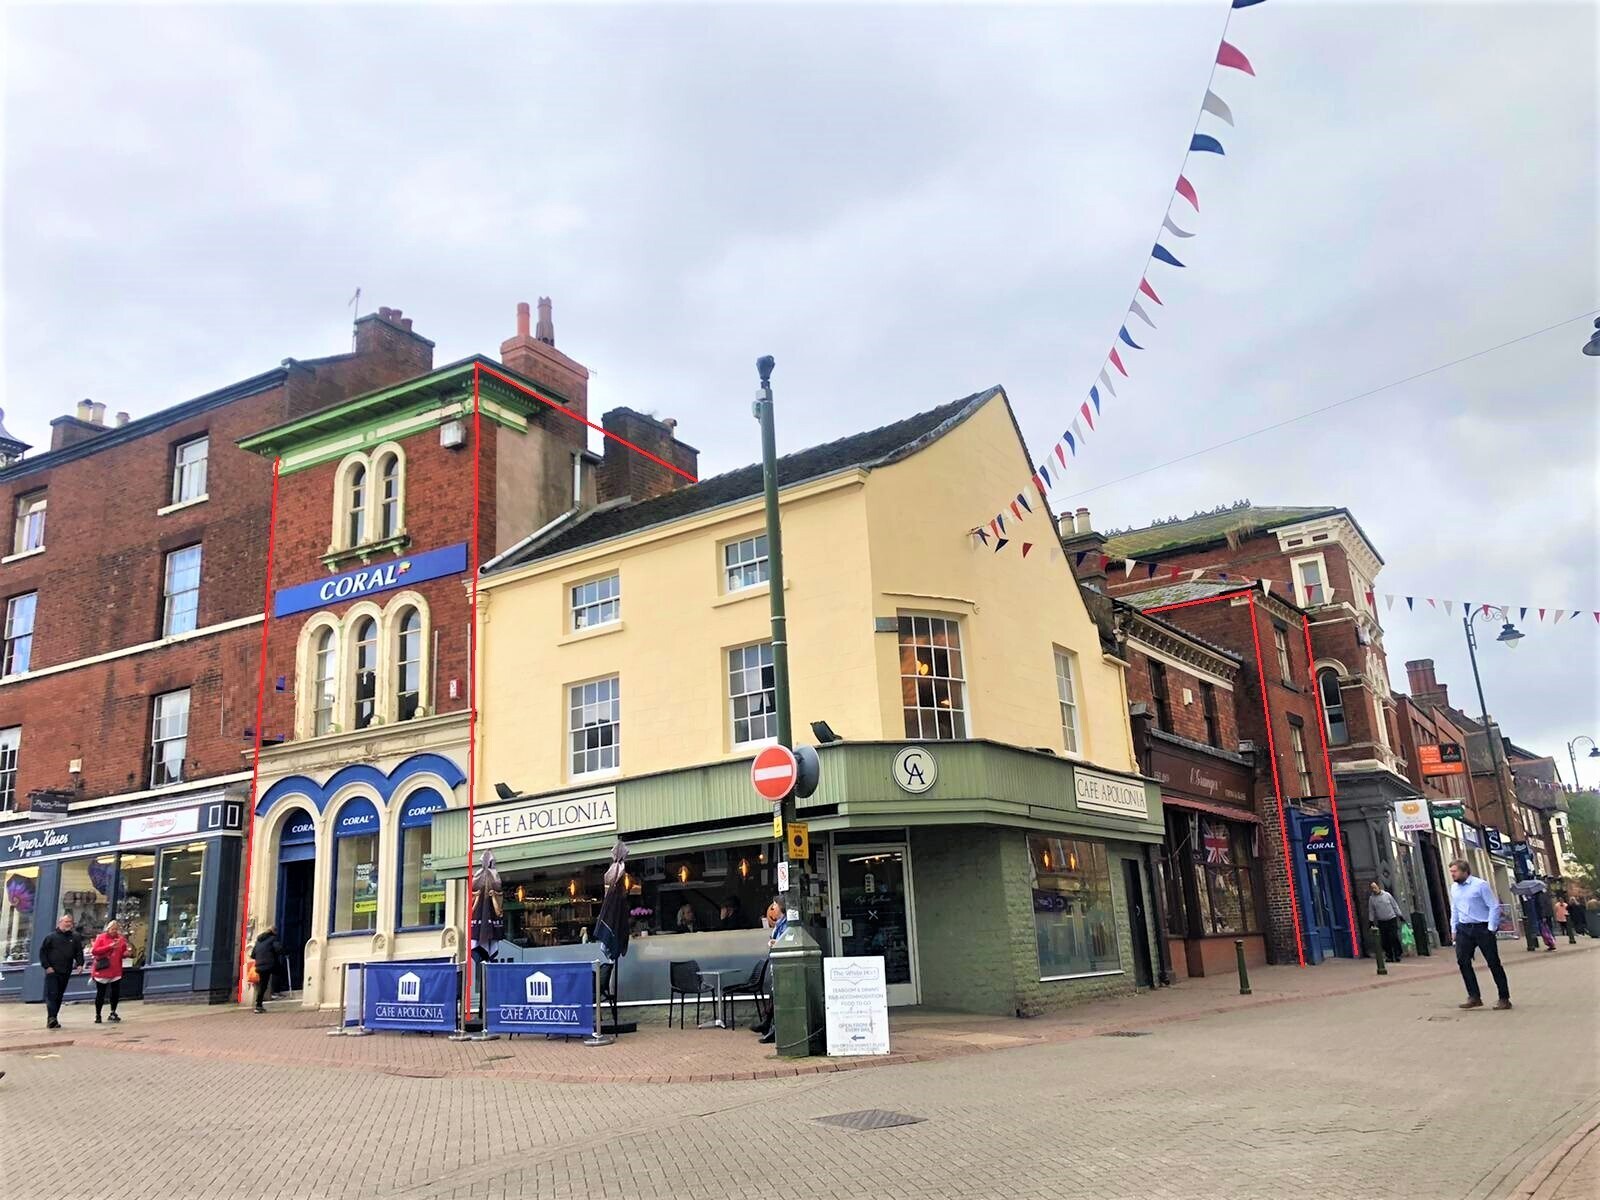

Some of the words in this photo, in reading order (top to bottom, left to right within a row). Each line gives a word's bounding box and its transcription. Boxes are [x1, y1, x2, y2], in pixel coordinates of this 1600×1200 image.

[320, 565, 397, 600] CORAL
[1077, 779, 1099, 799] CAFE
[1101, 784, 1145, 808] APOLLONIA
[342, 815, 370, 826] CORAL
[473, 816, 511, 838] CAFE
[516, 800, 612, 832] APOLLONIA
[292, 823, 316, 833] CORA
[8, 835, 42, 857] Paper
[40, 829, 68, 847] Kisses
[1306, 842, 1335, 850] CORAL
[375, 1006, 396, 1018] CAFE
[398, 1006, 444, 1019] APOLLONIA
[500, 1007, 524, 1020] CAFE
[526, 1008, 578, 1021] APOLLONIA
